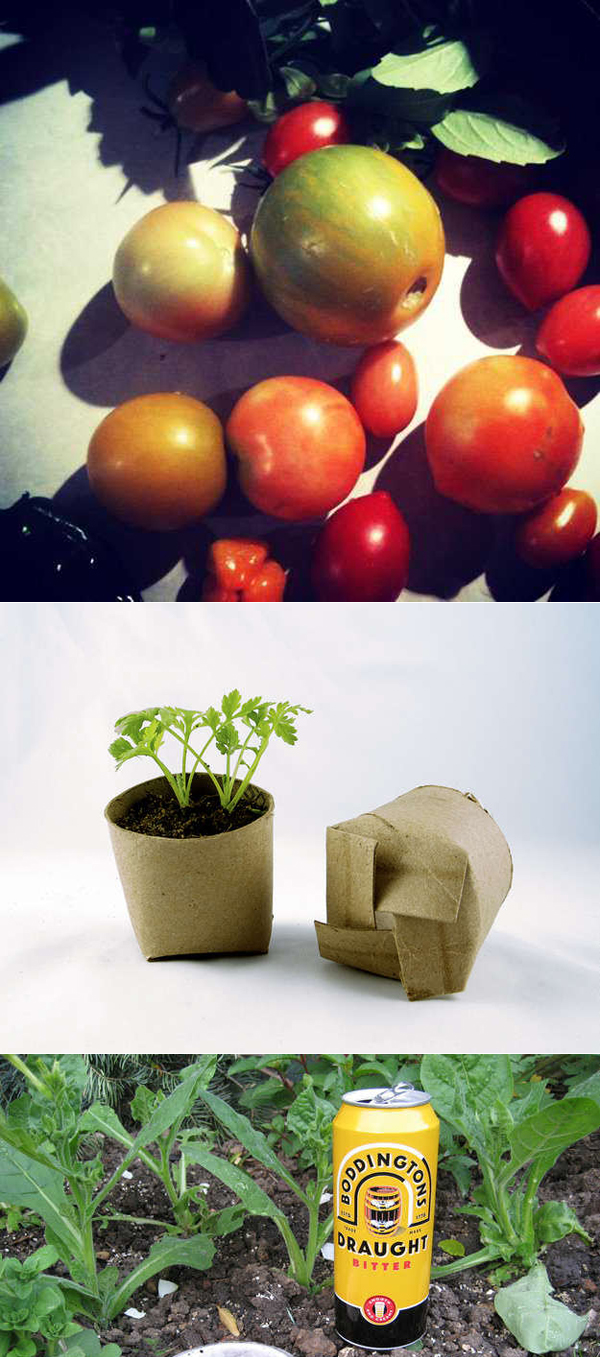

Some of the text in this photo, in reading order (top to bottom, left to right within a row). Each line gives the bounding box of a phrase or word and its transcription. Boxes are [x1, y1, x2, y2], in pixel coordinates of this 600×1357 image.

[341, 1153, 427, 1207] BODDINGTONS
[338, 1231, 428, 1257] DRAUGHT
[352, 1258, 412, 1271] BITTER
